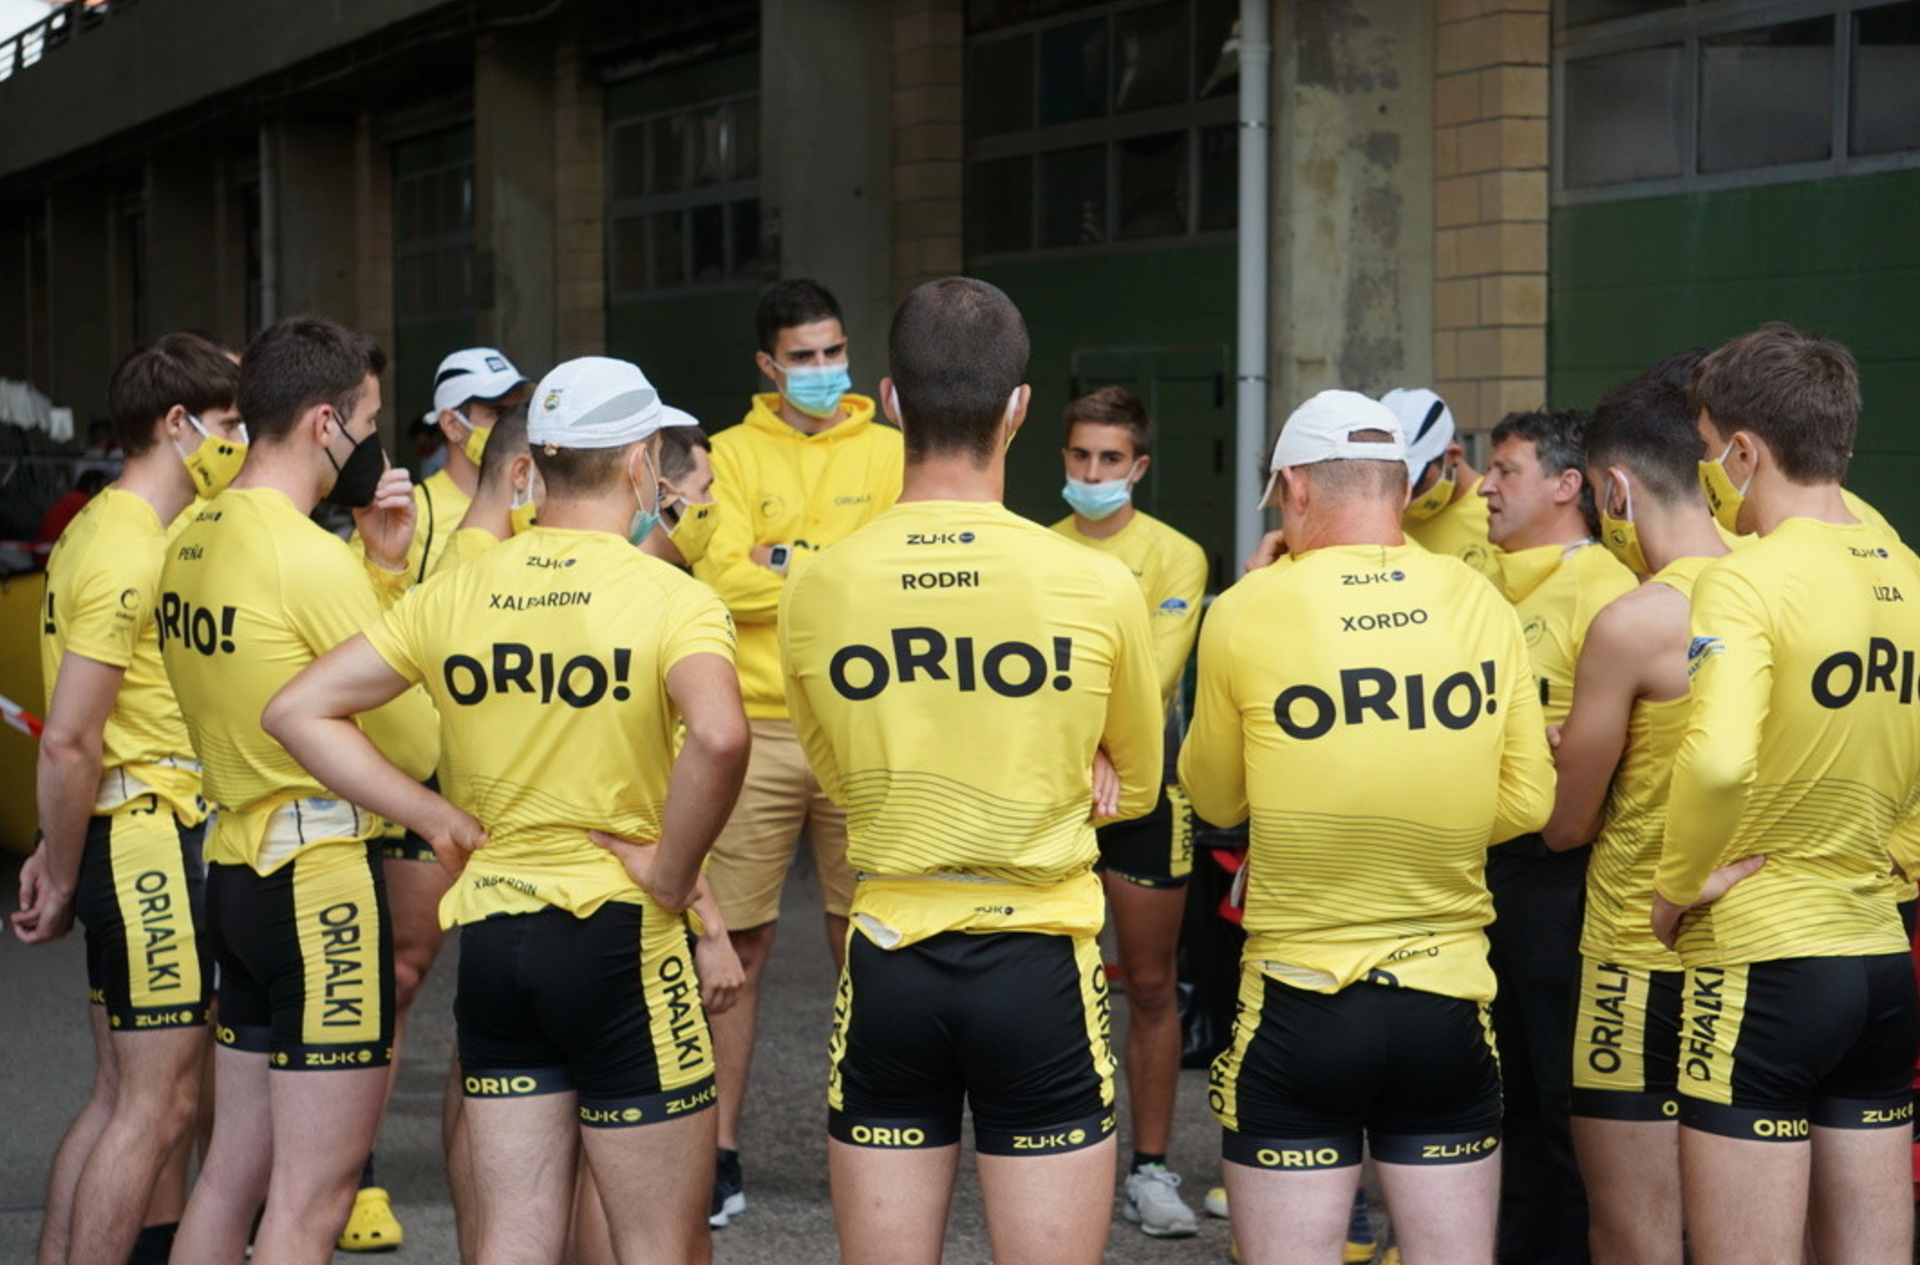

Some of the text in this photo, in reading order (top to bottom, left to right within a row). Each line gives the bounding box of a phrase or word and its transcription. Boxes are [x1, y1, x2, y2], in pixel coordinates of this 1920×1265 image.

[902, 571, 979, 590] RODRI
[155, 592, 237, 656] RIO!
[1340, 609, 1428, 632] XORDO
[443, 643, 632, 709] ORIO!
[829, 626, 1073, 701] ORIO!
[1811, 637, 1920, 709] ORI
[1274, 660, 1498, 740] ORIO!
[136, 871, 181, 993] ORIALKI
[319, 902, 364, 1027] ORIALKI
[466, 1077, 537, 1095] ORIO
[851, 1125, 925, 1146] ORIO
[1257, 1147, 1338, 1168] ORIO
[1753, 1118, 1809, 1137] ORIO
